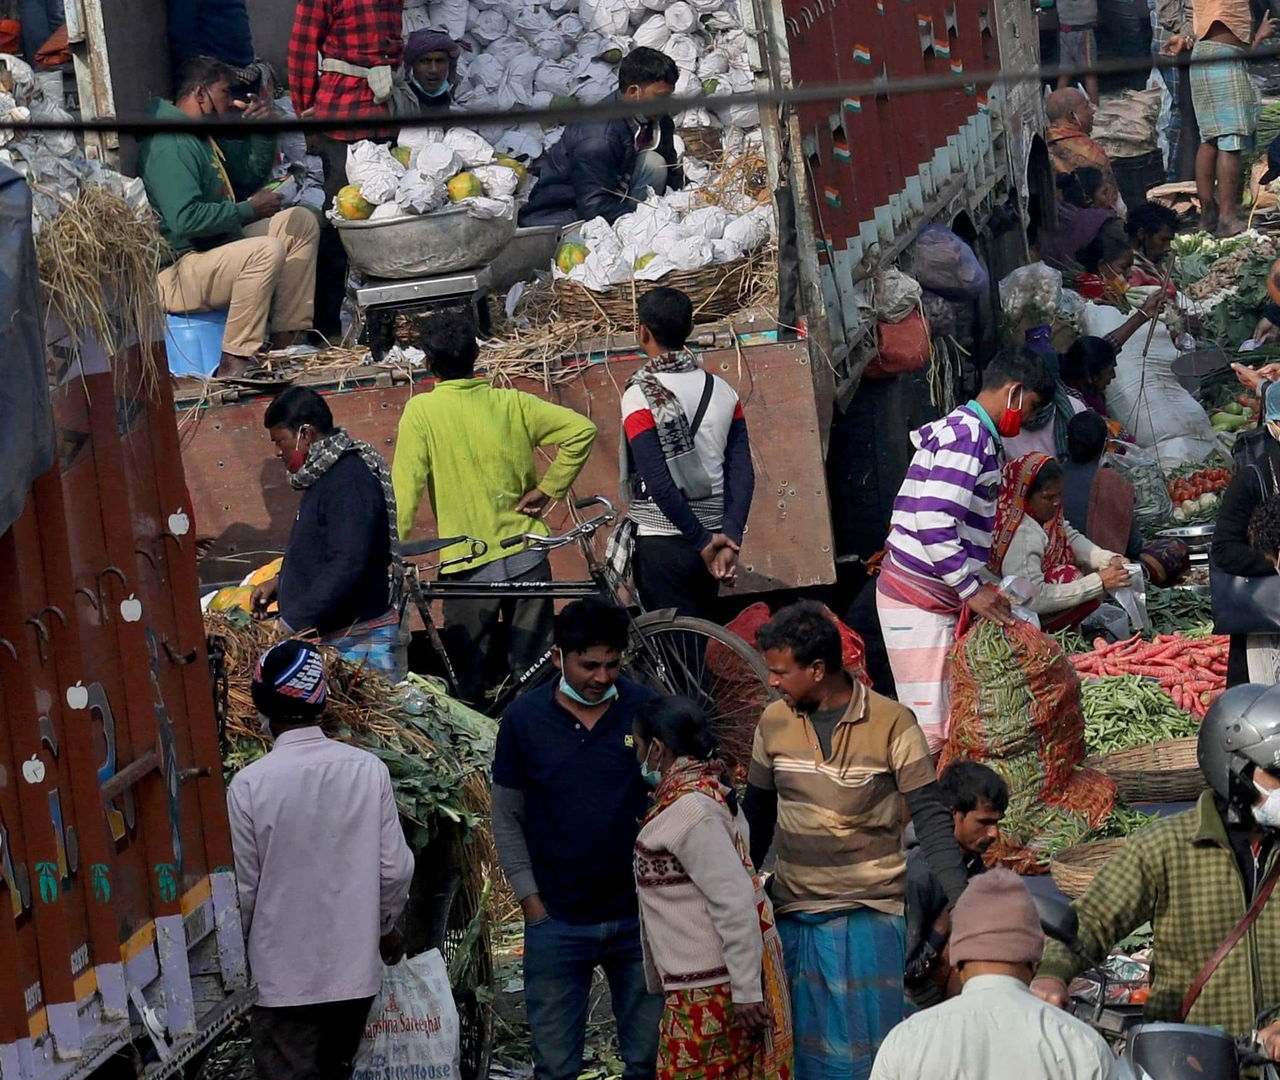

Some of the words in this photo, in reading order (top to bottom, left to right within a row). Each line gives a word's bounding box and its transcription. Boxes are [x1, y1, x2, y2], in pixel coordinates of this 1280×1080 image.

[292, 651, 324, 691] SERIES
[519, 649, 553, 683] NEELAM
[410, 1063, 451, 1080] House
